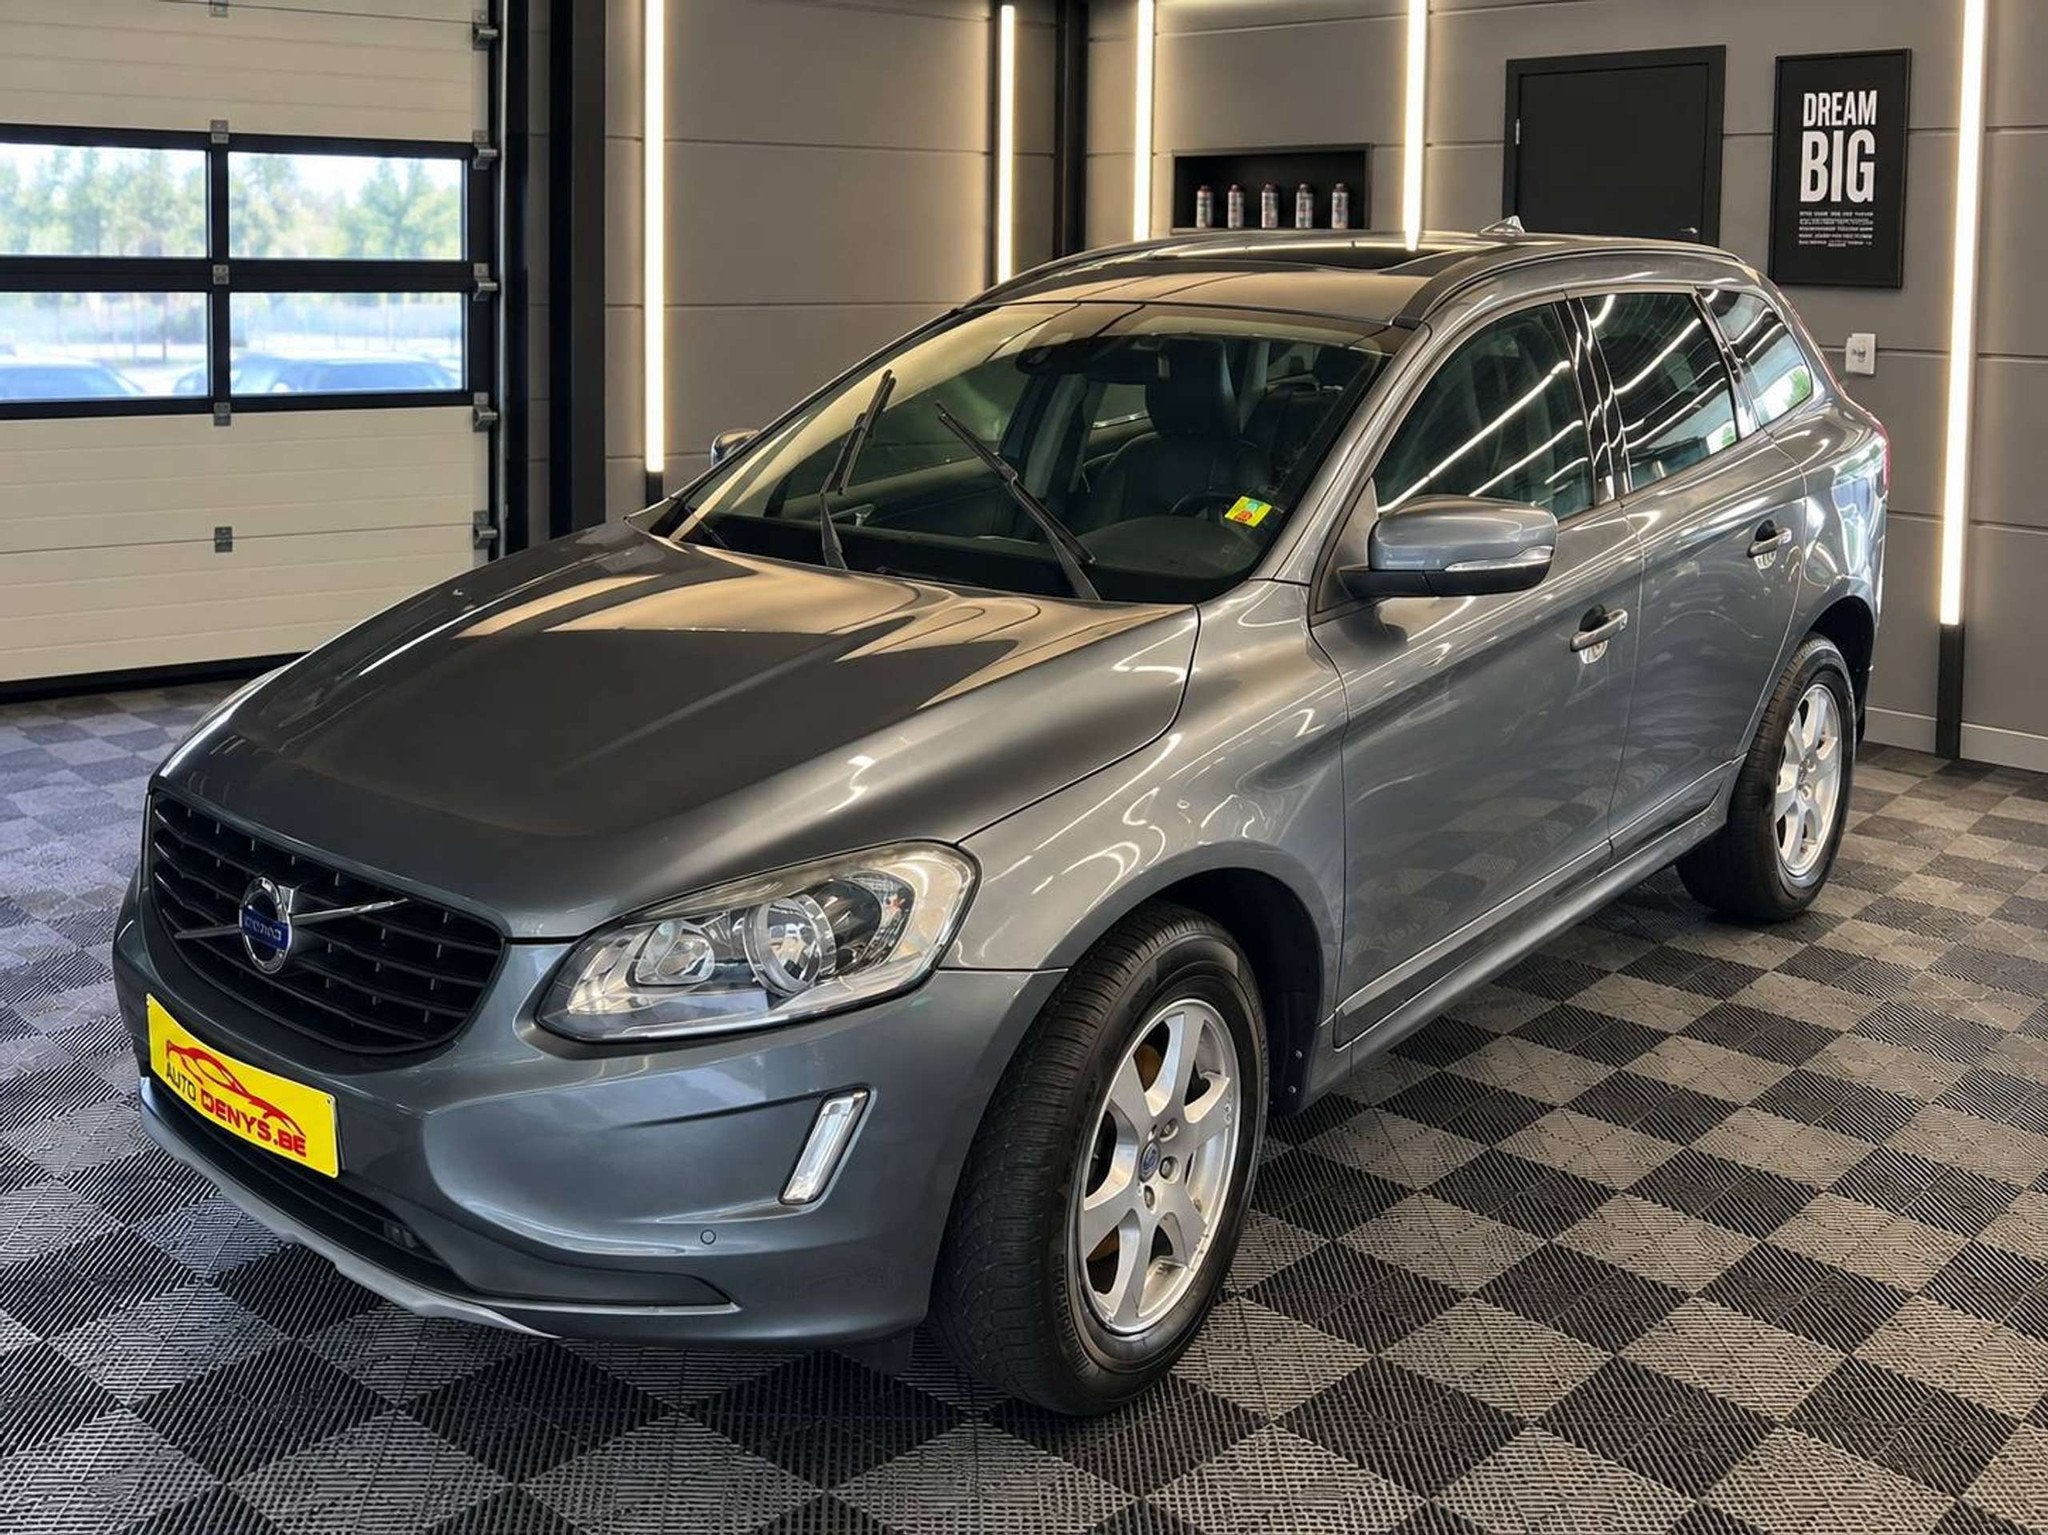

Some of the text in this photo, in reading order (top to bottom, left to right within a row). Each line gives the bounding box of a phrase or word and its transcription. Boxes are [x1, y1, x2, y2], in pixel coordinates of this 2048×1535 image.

[1803, 90, 1877, 127] DREAM
[1800, 129, 1876, 203] BIG
[166, 1062, 197, 1101] AUTO
